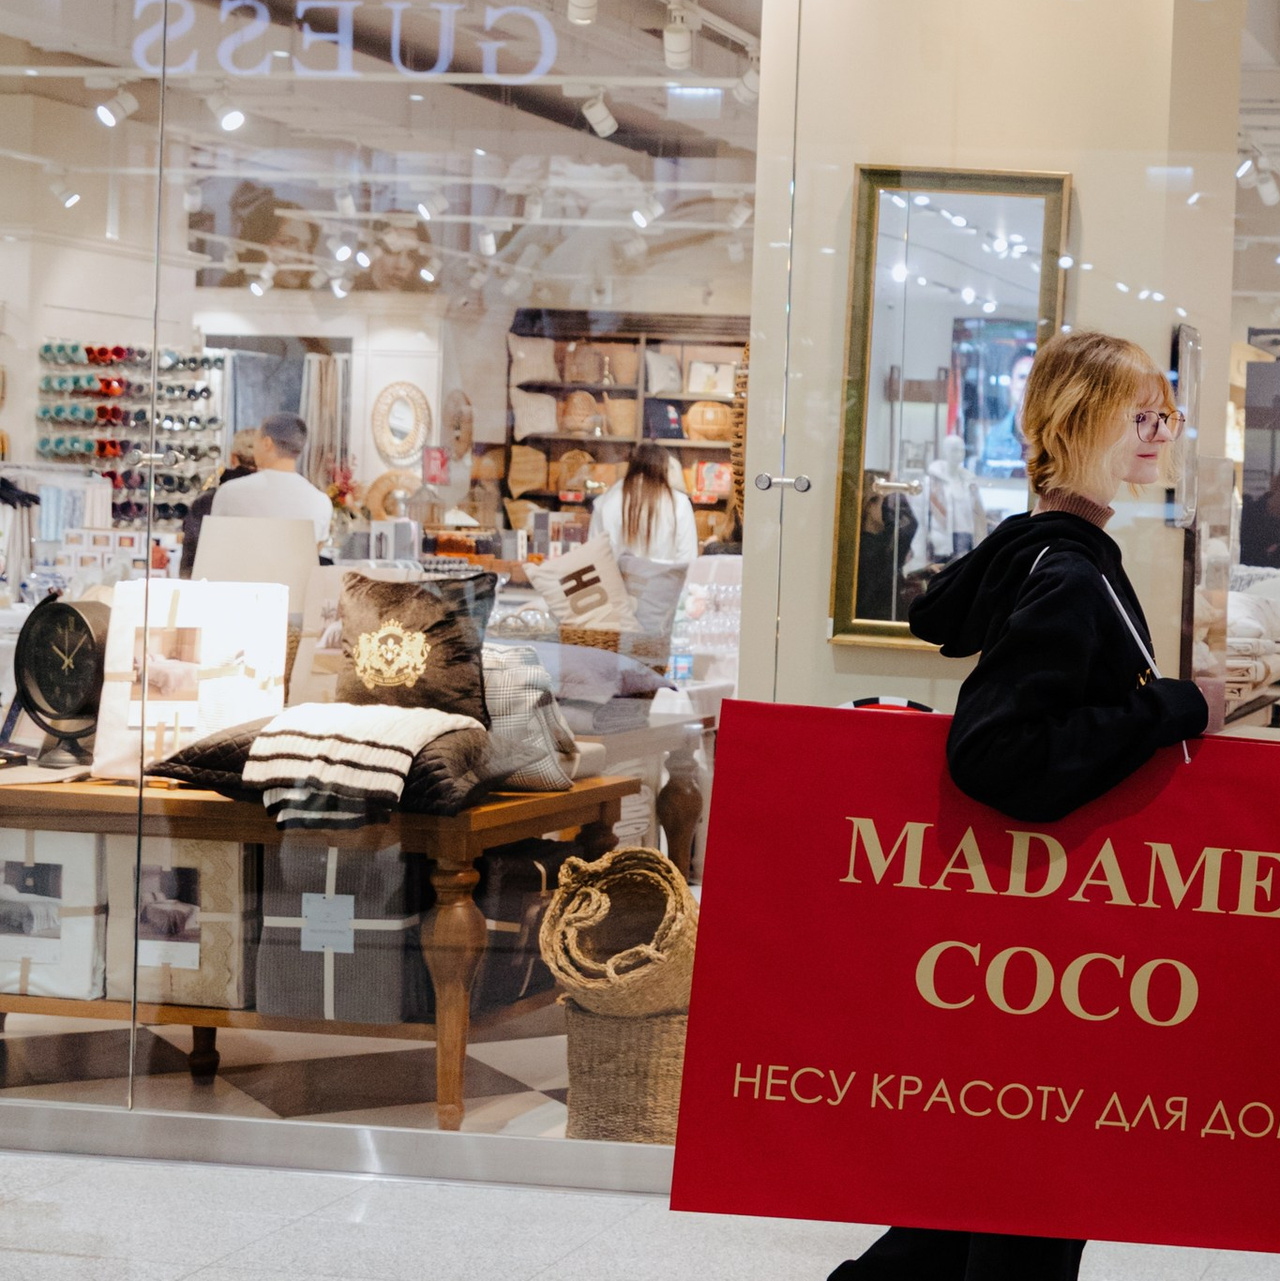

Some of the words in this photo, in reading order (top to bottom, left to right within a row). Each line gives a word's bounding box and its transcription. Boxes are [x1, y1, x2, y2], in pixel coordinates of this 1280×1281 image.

[915, 940, 1199, 1027] COCO
[733, 1062, 856, 1106] НЕСУ
[870, 1073, 1084, 1123] КРАСОТУ
[1095, 1091, 1188, 1132] ДЛЯ
